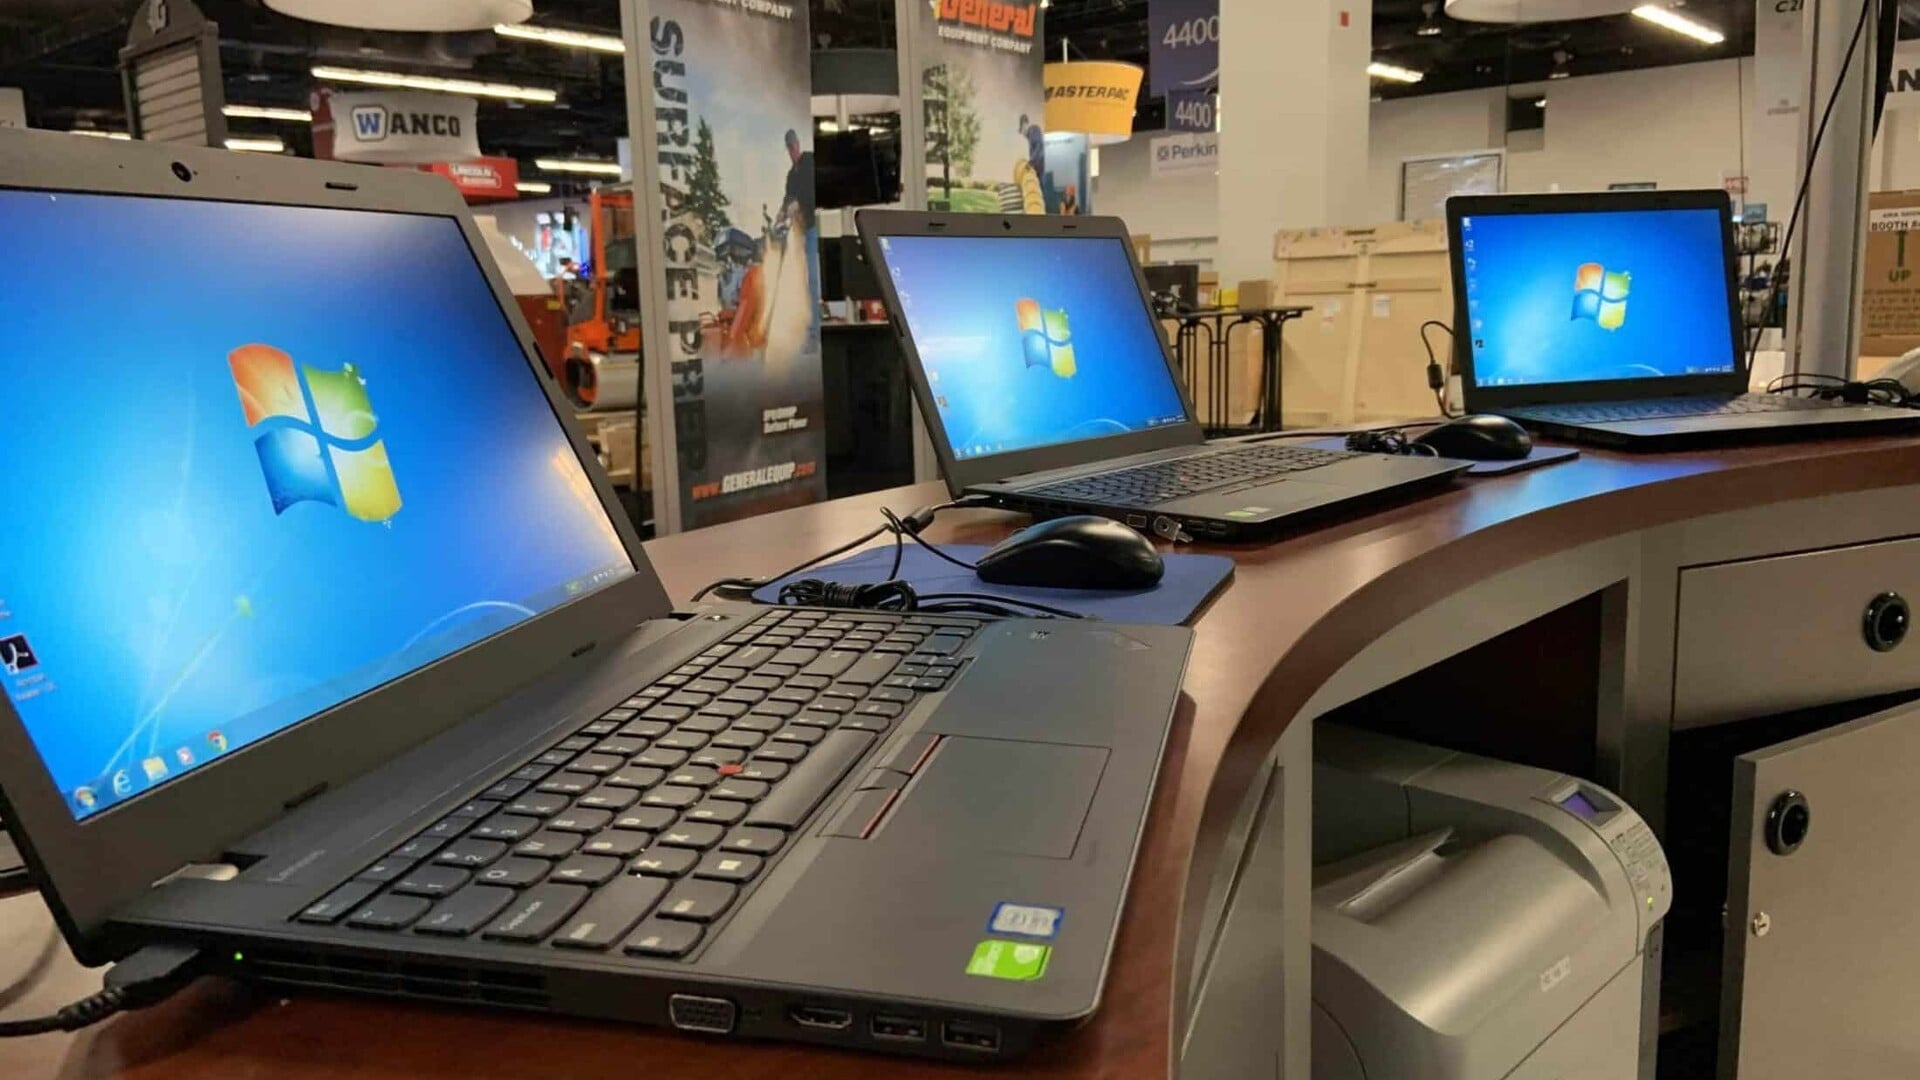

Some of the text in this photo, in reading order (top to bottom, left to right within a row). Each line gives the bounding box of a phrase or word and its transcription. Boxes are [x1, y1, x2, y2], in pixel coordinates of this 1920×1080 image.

[741, 0, 793, 19] COMPANY
[939, 0, 1036, 37] General
[1162, 15, 1220, 49] 4400
[356, 111, 462, 138] WANCO
[1174, 100, 1212, 128] 4400
[650, 16, 701, 301] SURFACE
[1172, 142, 1219, 160] Perkin
[1871, 220, 1908, 231] BOOTH
[1888, 269, 1911, 283] UP
